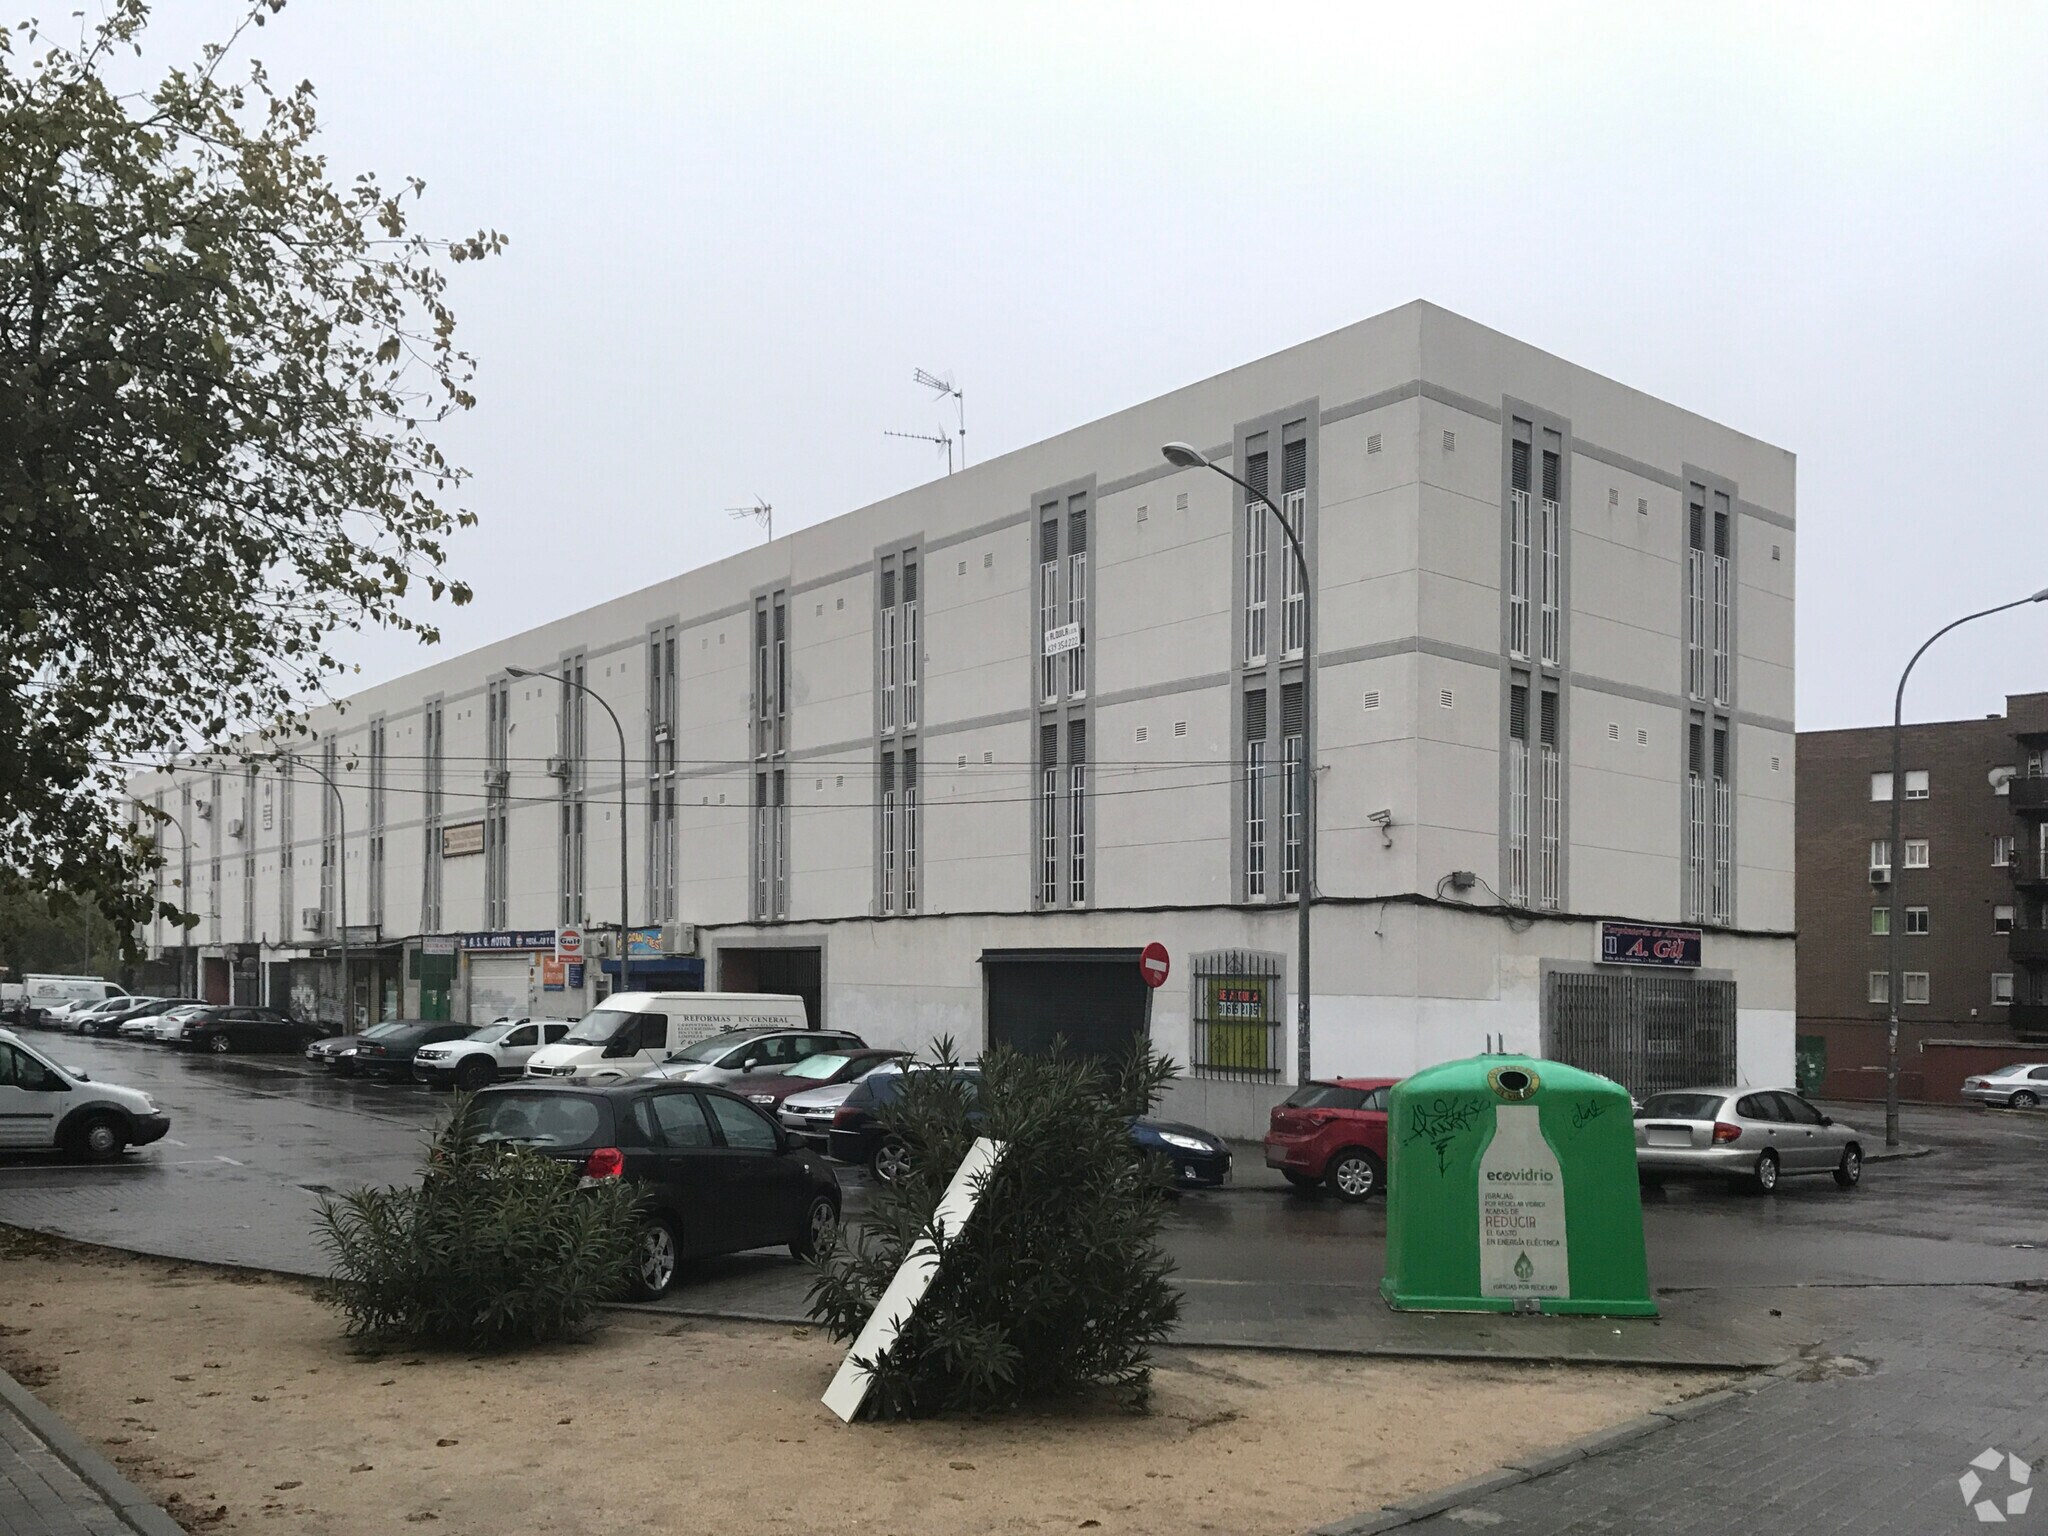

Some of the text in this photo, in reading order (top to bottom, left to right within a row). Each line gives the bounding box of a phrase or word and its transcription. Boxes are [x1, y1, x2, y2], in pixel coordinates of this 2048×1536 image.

[491, 936, 511, 947] MOTOR
[560, 937, 580, 945] Gulf
[646, 935, 663, 950] FIEST
[1626, 938, 1685, 959] A. Gil
[1487, 1168, 1553, 1181] ecovidrio
[1485, 1216, 1536, 1228] REDUCIR
[1497, 1238, 1524, 1246] ENERGÍA
[1526, 1238, 1560, 1246] ELÉCTRICA
